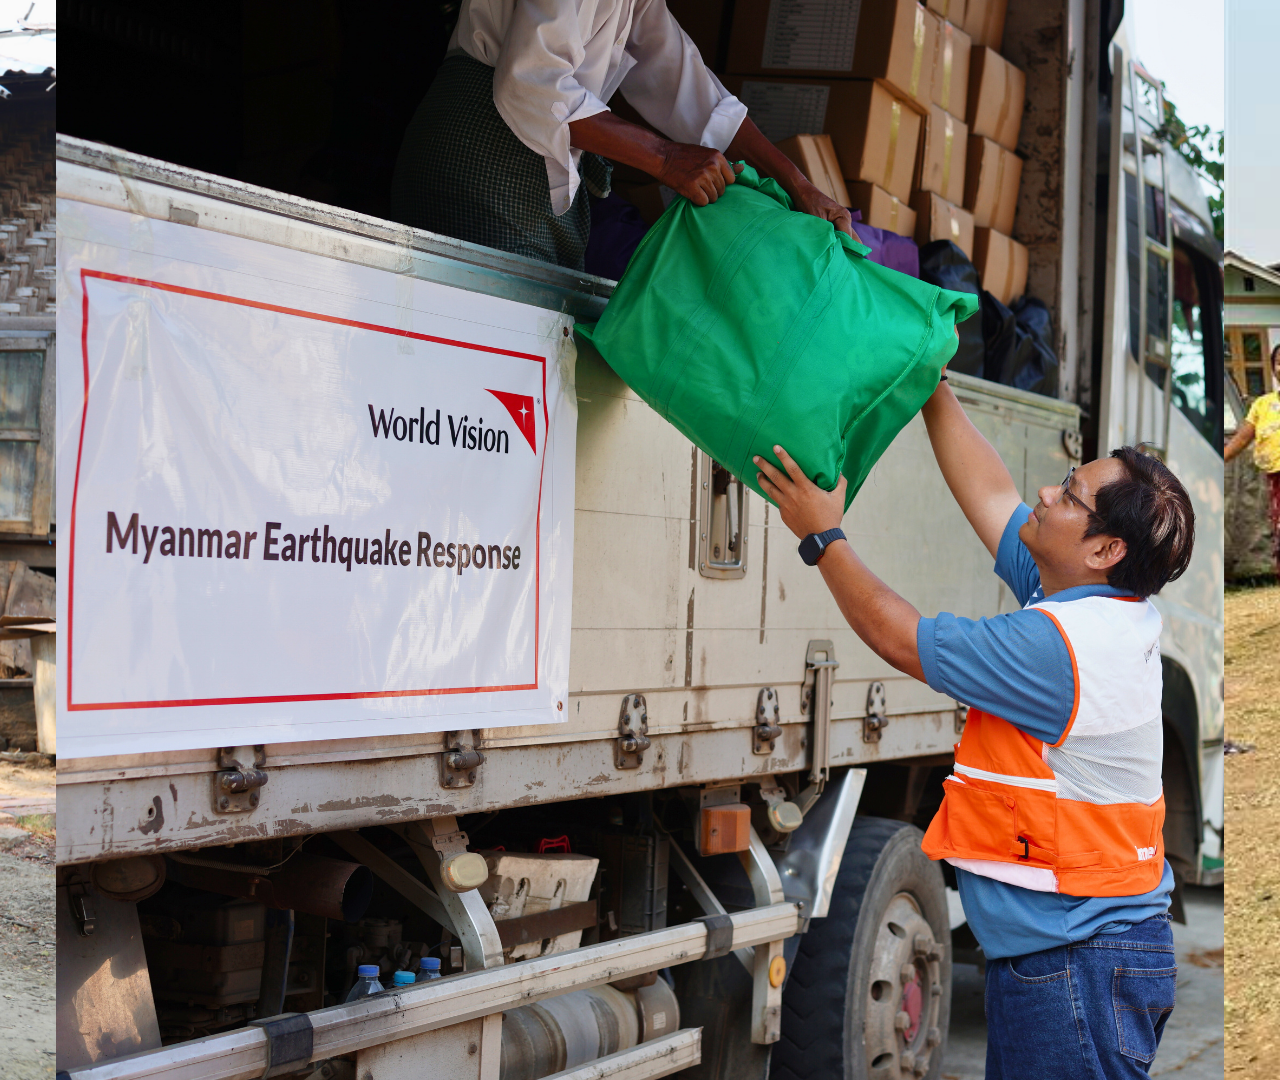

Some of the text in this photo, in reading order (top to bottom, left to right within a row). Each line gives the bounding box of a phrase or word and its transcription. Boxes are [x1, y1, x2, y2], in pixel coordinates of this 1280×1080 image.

[368, 404, 509, 454] World Vision
[106, 511, 521, 575] Myanmar Earthquake Response
